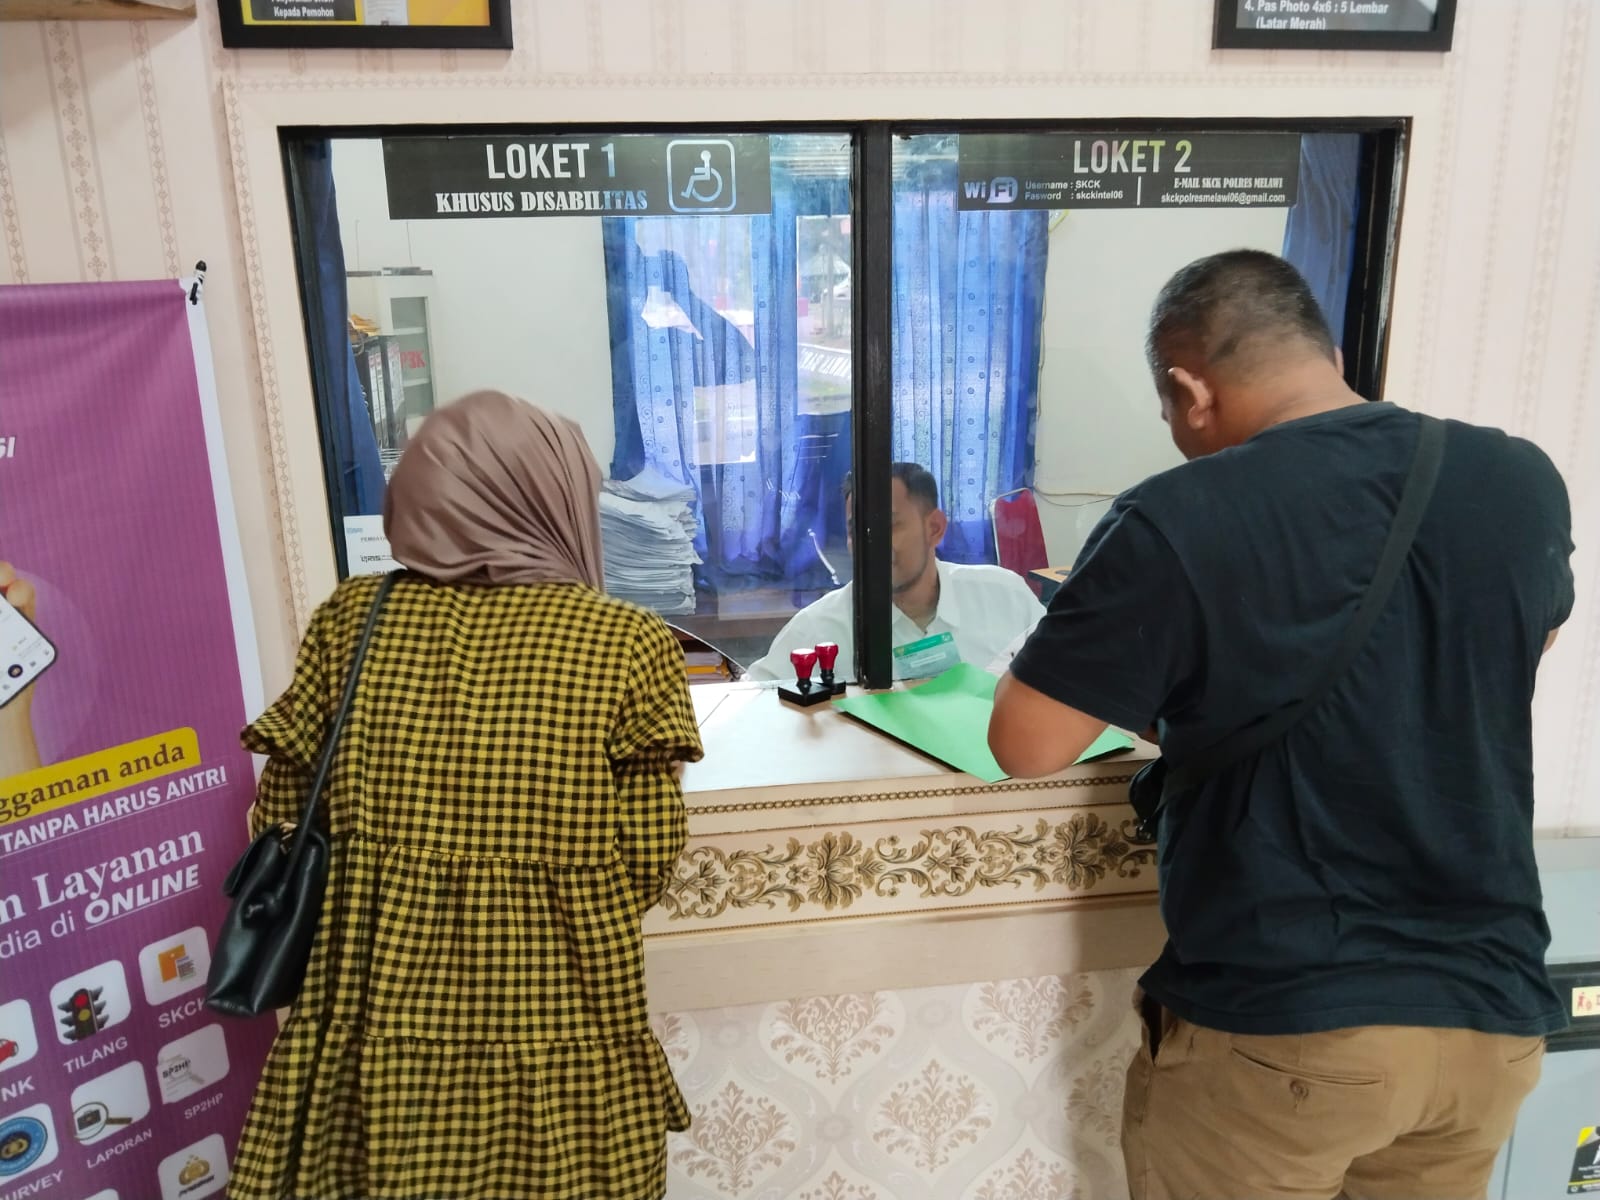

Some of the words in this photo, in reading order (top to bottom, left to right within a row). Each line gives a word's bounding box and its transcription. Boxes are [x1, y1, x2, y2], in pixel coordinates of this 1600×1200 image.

[273, 6, 301, 19] Kepada
[301, 6, 334, 17] Pemohon
[1256, 16, 1288, 29] (Latar
[1290, 17, 1326, 30] Merah)
[1257, 0, 1277, 12] Pas
[1279, 1, 1310, 12] Photo
[1312, 1, 1332, 13] 4x6
[1340, 1, 1347, 13] 5
[1350, 2, 1389, 14] Lembar
[486, 143, 590, 179] LOKET
[601, 143, 616, 178] 1
[1073, 140, 1166, 175] LOKET
[1174, 139, 1193, 174] 2
[1025, 180, 1068, 190] Username
[1075, 180, 1101, 189] SKCK
[1174, 177, 1200, 189] E-MAIL
[1201, 177, 1222, 189] SKCK
[1223, 177, 1253, 189] POLRES
[1254, 177, 1283, 189] MELAWI
[435, 191, 515, 214] KHUSUS
[521, 189, 649, 213] DISABILITAS
[119, 743, 186, 778] anda
[0, 813, 79, 853] TANPA
[83, 786, 161, 827] HARUS
[166, 765, 227, 801] ANTRI
[32, 830, 206, 911] Layanan
[51, 910, 76, 938] di
[84, 864, 200, 925] ONLINE
[63, 1036, 129, 1075] TILANG
[184, 1092, 224, 1121] SP2HP
[86, 1128, 153, 1170] LAPORAN
[0, 1169, 63, 1200] URVEY
